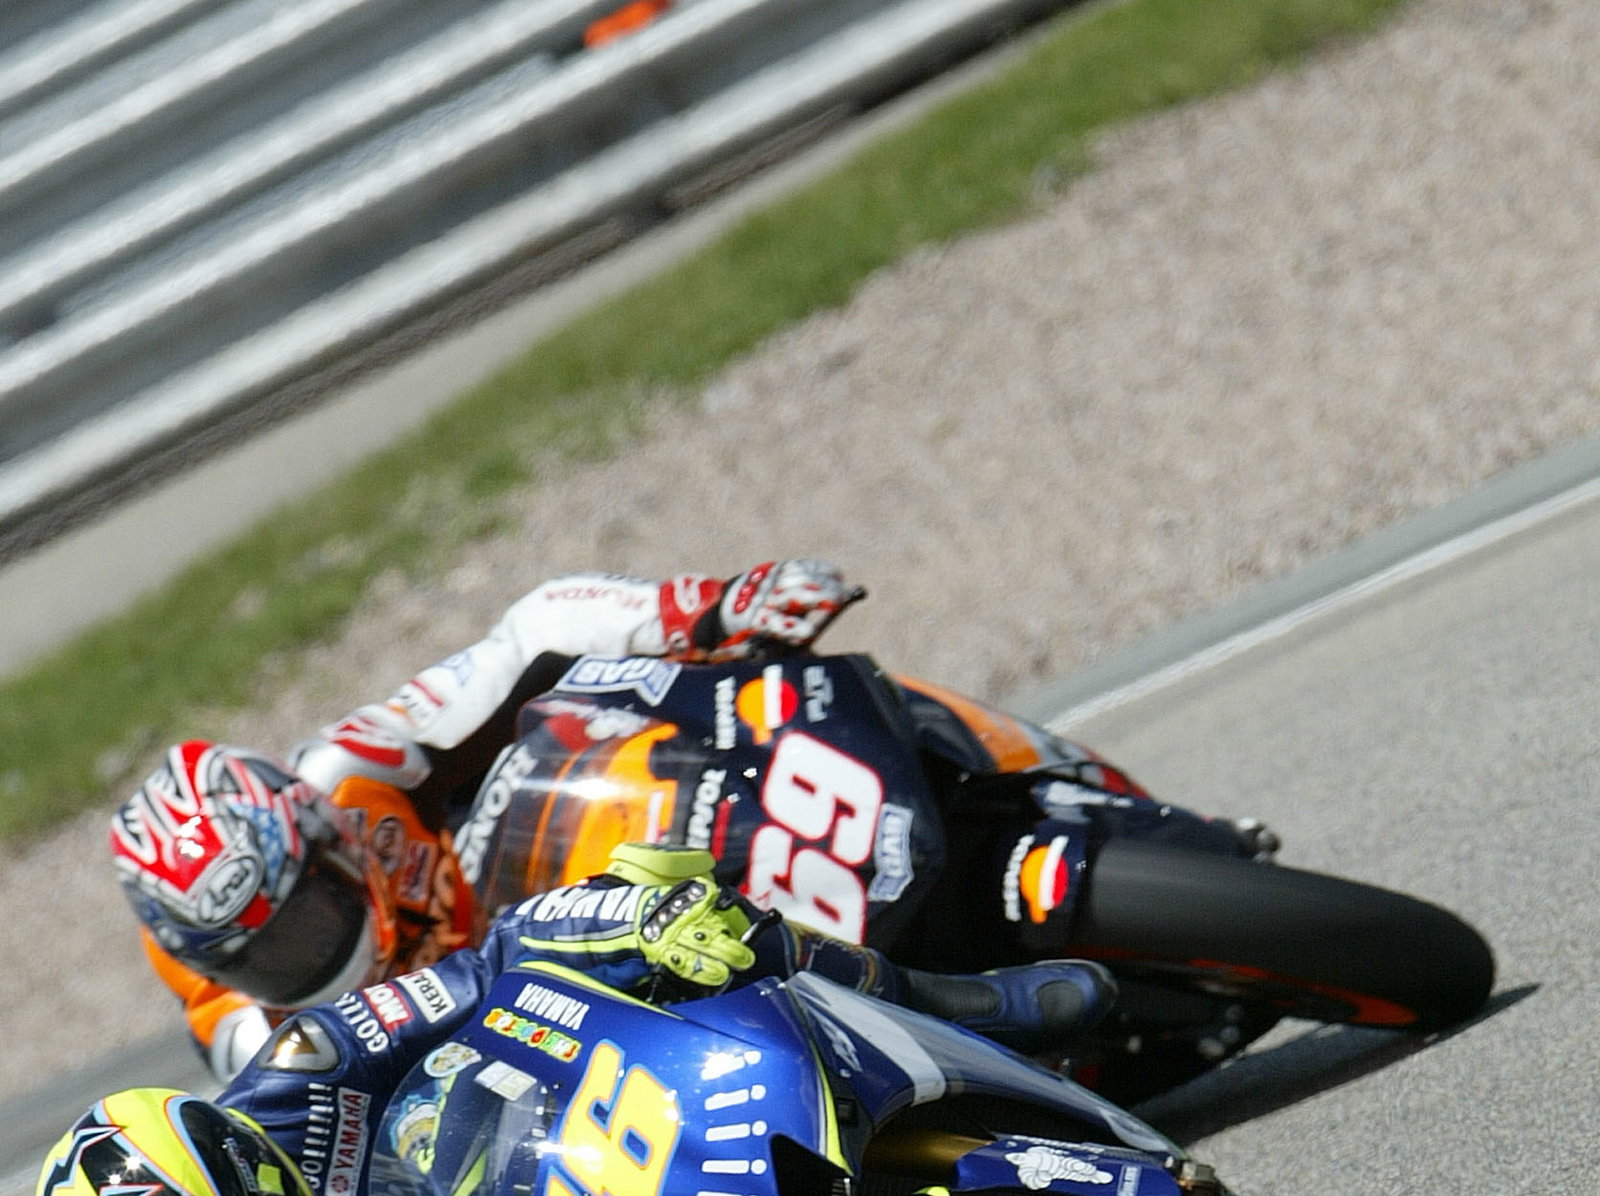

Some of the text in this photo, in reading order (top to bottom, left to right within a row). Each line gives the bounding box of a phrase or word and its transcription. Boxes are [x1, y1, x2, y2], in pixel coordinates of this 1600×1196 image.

[740, 731, 884, 945] 69
[513, 983, 590, 1030] YAMAHA
[332, 1092, 363, 1172] YAMAHA
